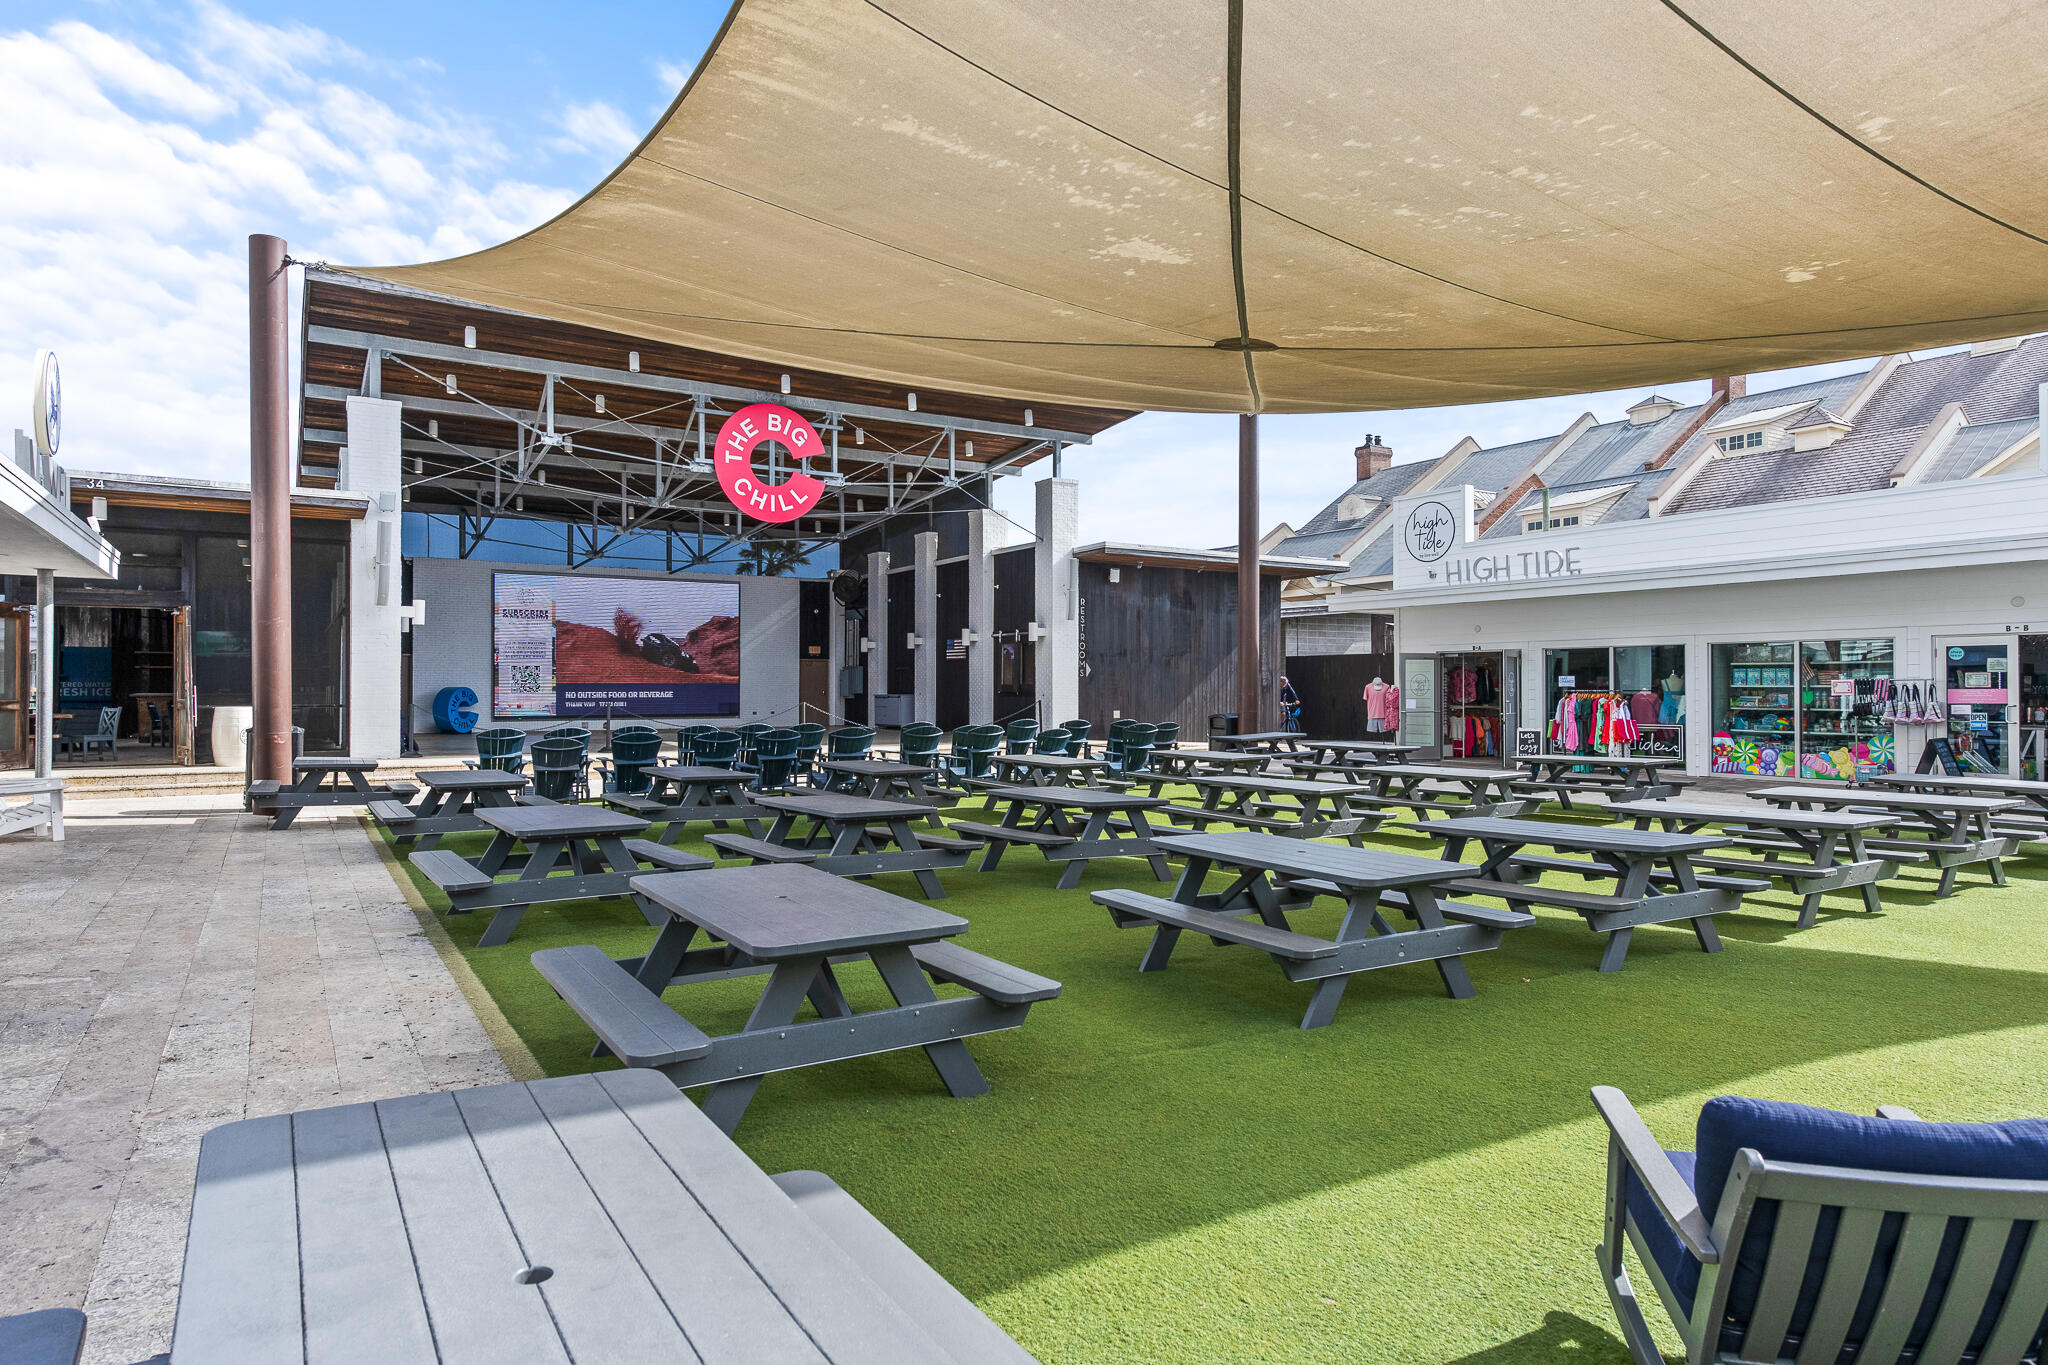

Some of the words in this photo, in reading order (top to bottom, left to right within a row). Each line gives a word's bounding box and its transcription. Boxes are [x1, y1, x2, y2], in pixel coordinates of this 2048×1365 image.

[725, 418, 759, 463] THE
[767, 413, 808, 447] BIG
[87, 478, 104, 489] 34
[734, 478, 809, 512] CHILL
[1413, 509, 1448, 541] high
[1446, 555, 1510, 584] HIGH
[1517, 547, 1582, 577] TIDE
[92, 688, 112, 697] ICE
[565, 691, 576, 699] NO
[577, 691, 607, 699] OUTSIDE
[608, 691, 627, 699] FOOD
[1970, 713, 1987, 721] OPEN
[1520, 744, 1539, 753] cozy
